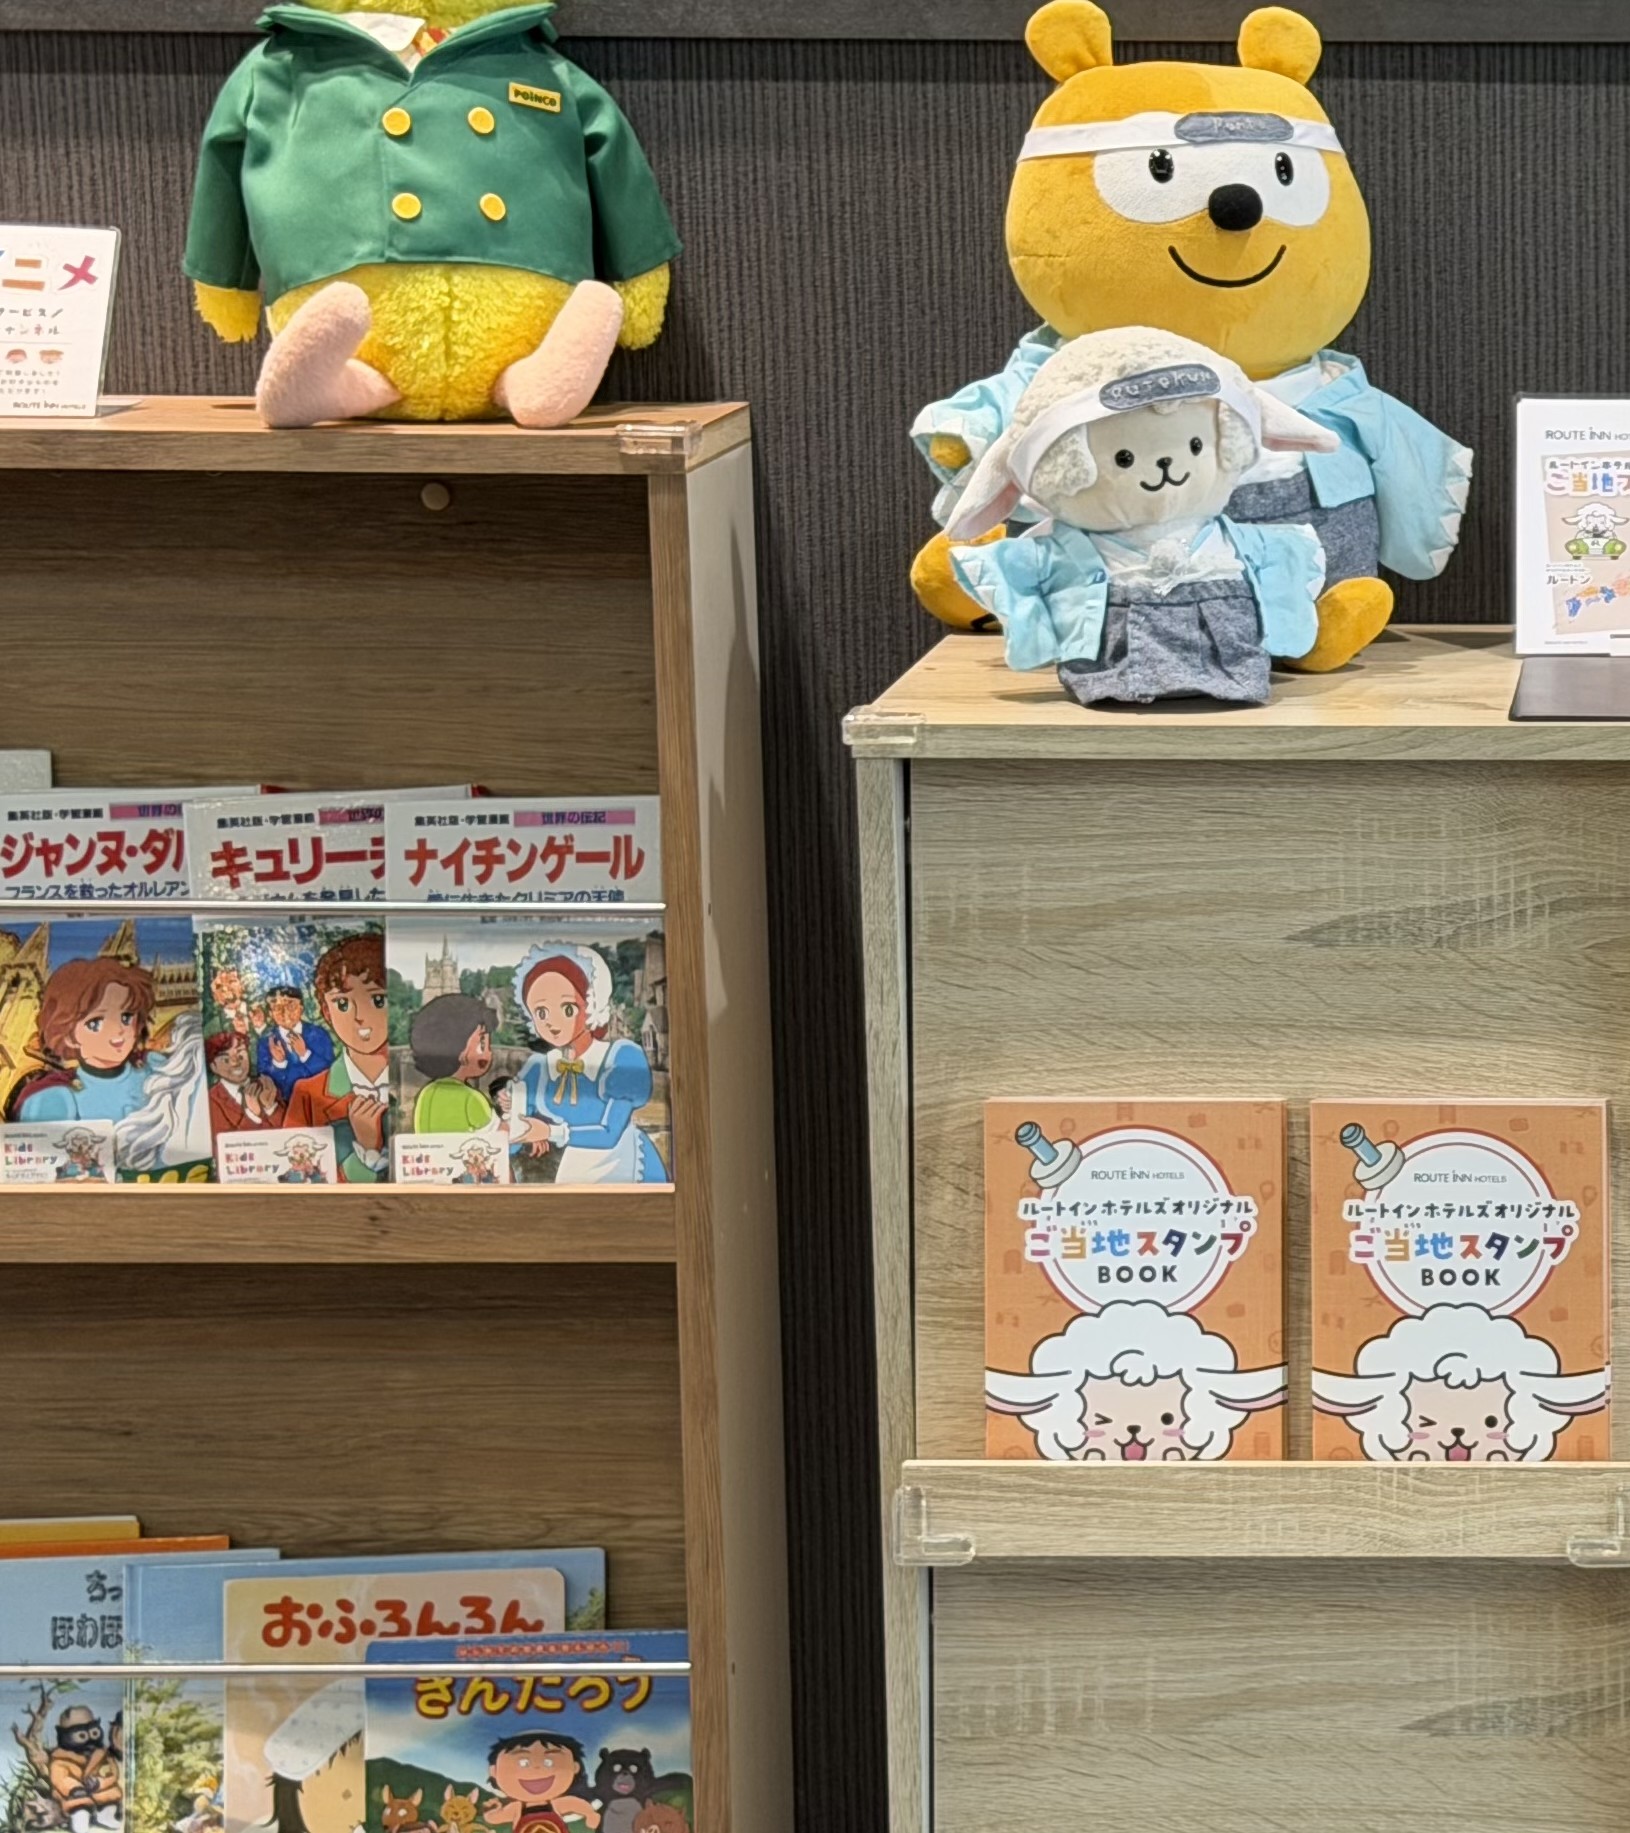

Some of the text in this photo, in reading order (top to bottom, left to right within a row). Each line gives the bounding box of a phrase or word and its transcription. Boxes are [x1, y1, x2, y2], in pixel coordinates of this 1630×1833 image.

[0, 250, 98, 292] ニメ
[1545, 430, 1586, 440] ROUTE
[1546, 574, 1592, 585] ルートン
[404, 833, 645, 887] ナイチンゲール
[226, 1165, 280, 1175] Library
[402, 1166, 454, 1177] Library
[1091, 1170, 1128, 1180] ROUTE
[1152, 1172, 1185, 1180] HOTELS
[1413, 1173, 1450, 1183] ROUTE
[1474, 1175, 1507, 1183] HOTELS
[1023, 1197, 1253, 1216] ルートインホテルズオリジナル
[1347, 1201, 1575, 1219] ルートインホテルズオリジナル
[1030, 1220, 1251, 1260] ご当地スタンプ
[1354, 1224, 1574, 1262] ご当地スタンプ
[1097, 1265, 1178, 1284] BOOK
[1421, 1268, 1501, 1287] BOOK
[262, 1595, 545, 1648] おふろんろん
